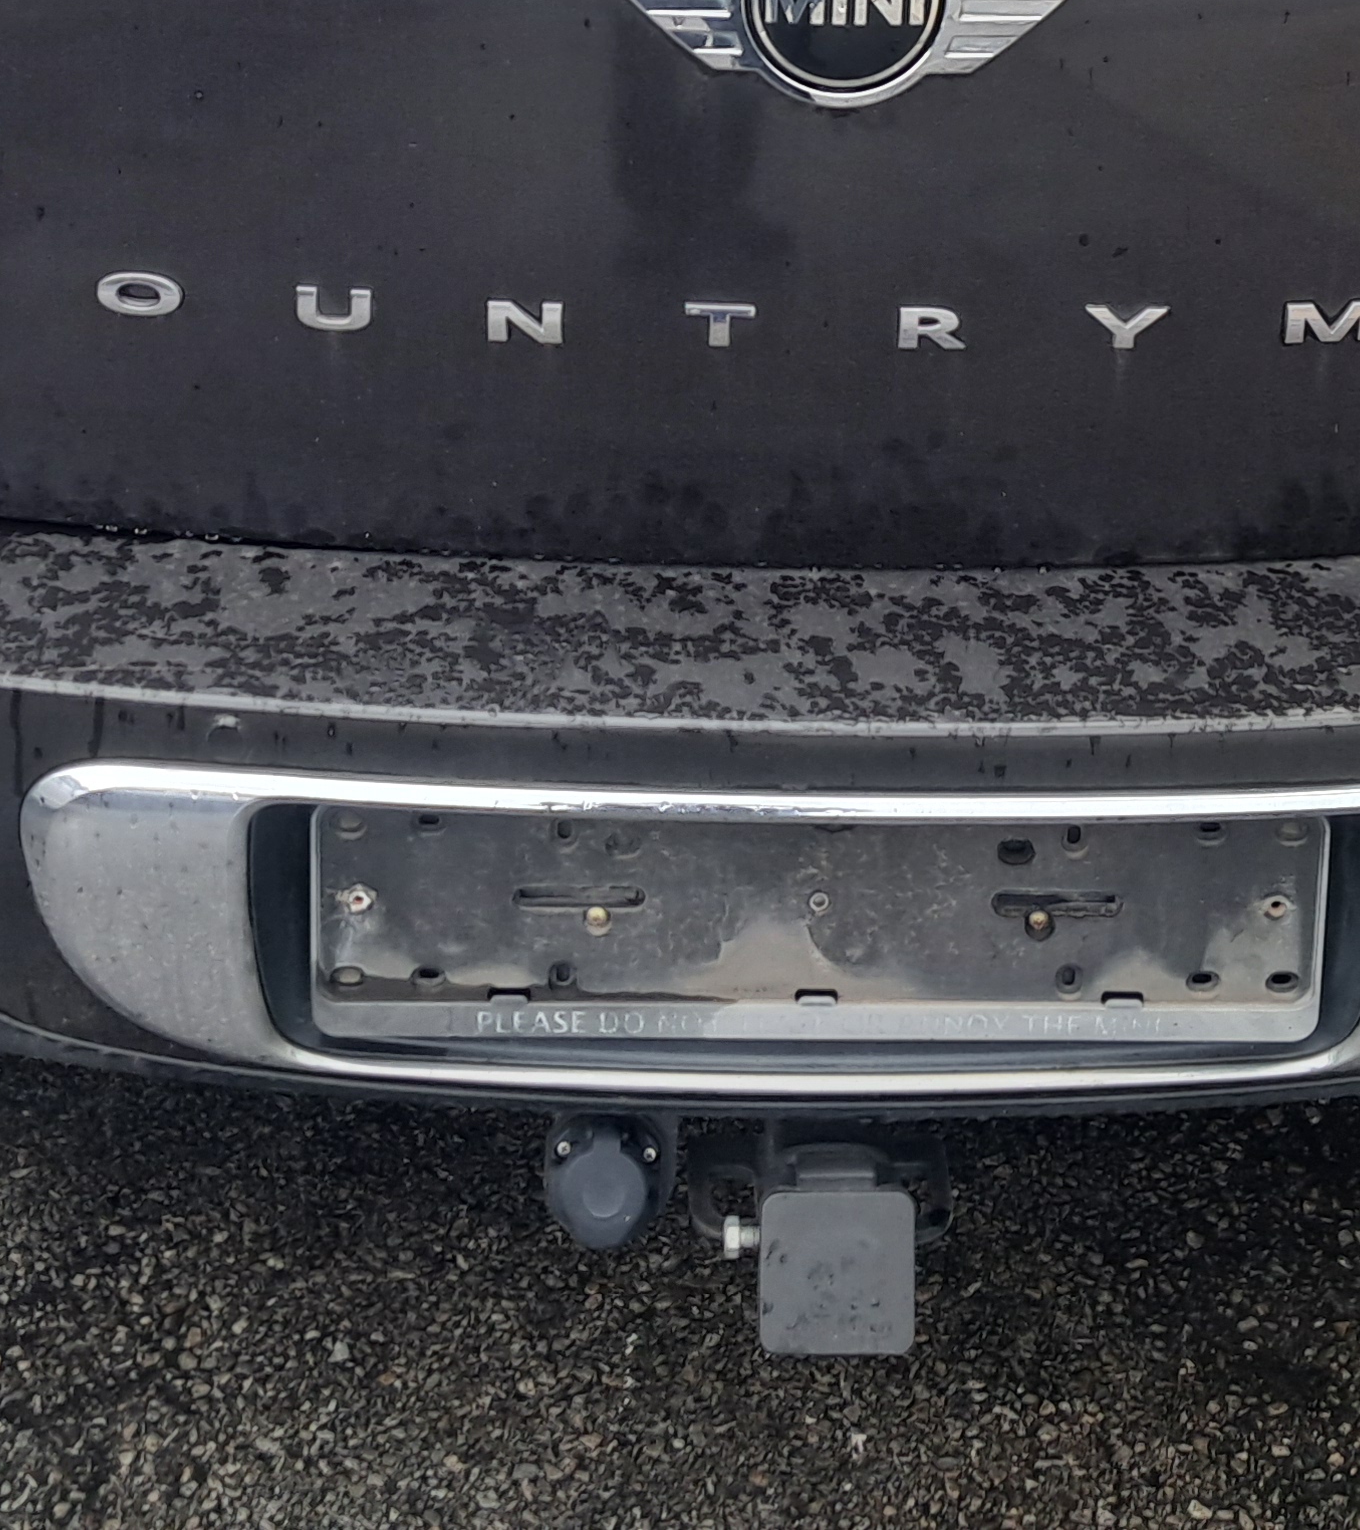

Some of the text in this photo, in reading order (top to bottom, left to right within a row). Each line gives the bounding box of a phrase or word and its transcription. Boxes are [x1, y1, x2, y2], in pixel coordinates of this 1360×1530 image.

[476, 1010, 587, 1035] PLEASE
[598, 1011, 645, 1034] DO
[1094, 1015, 1161, 1036] MNI
